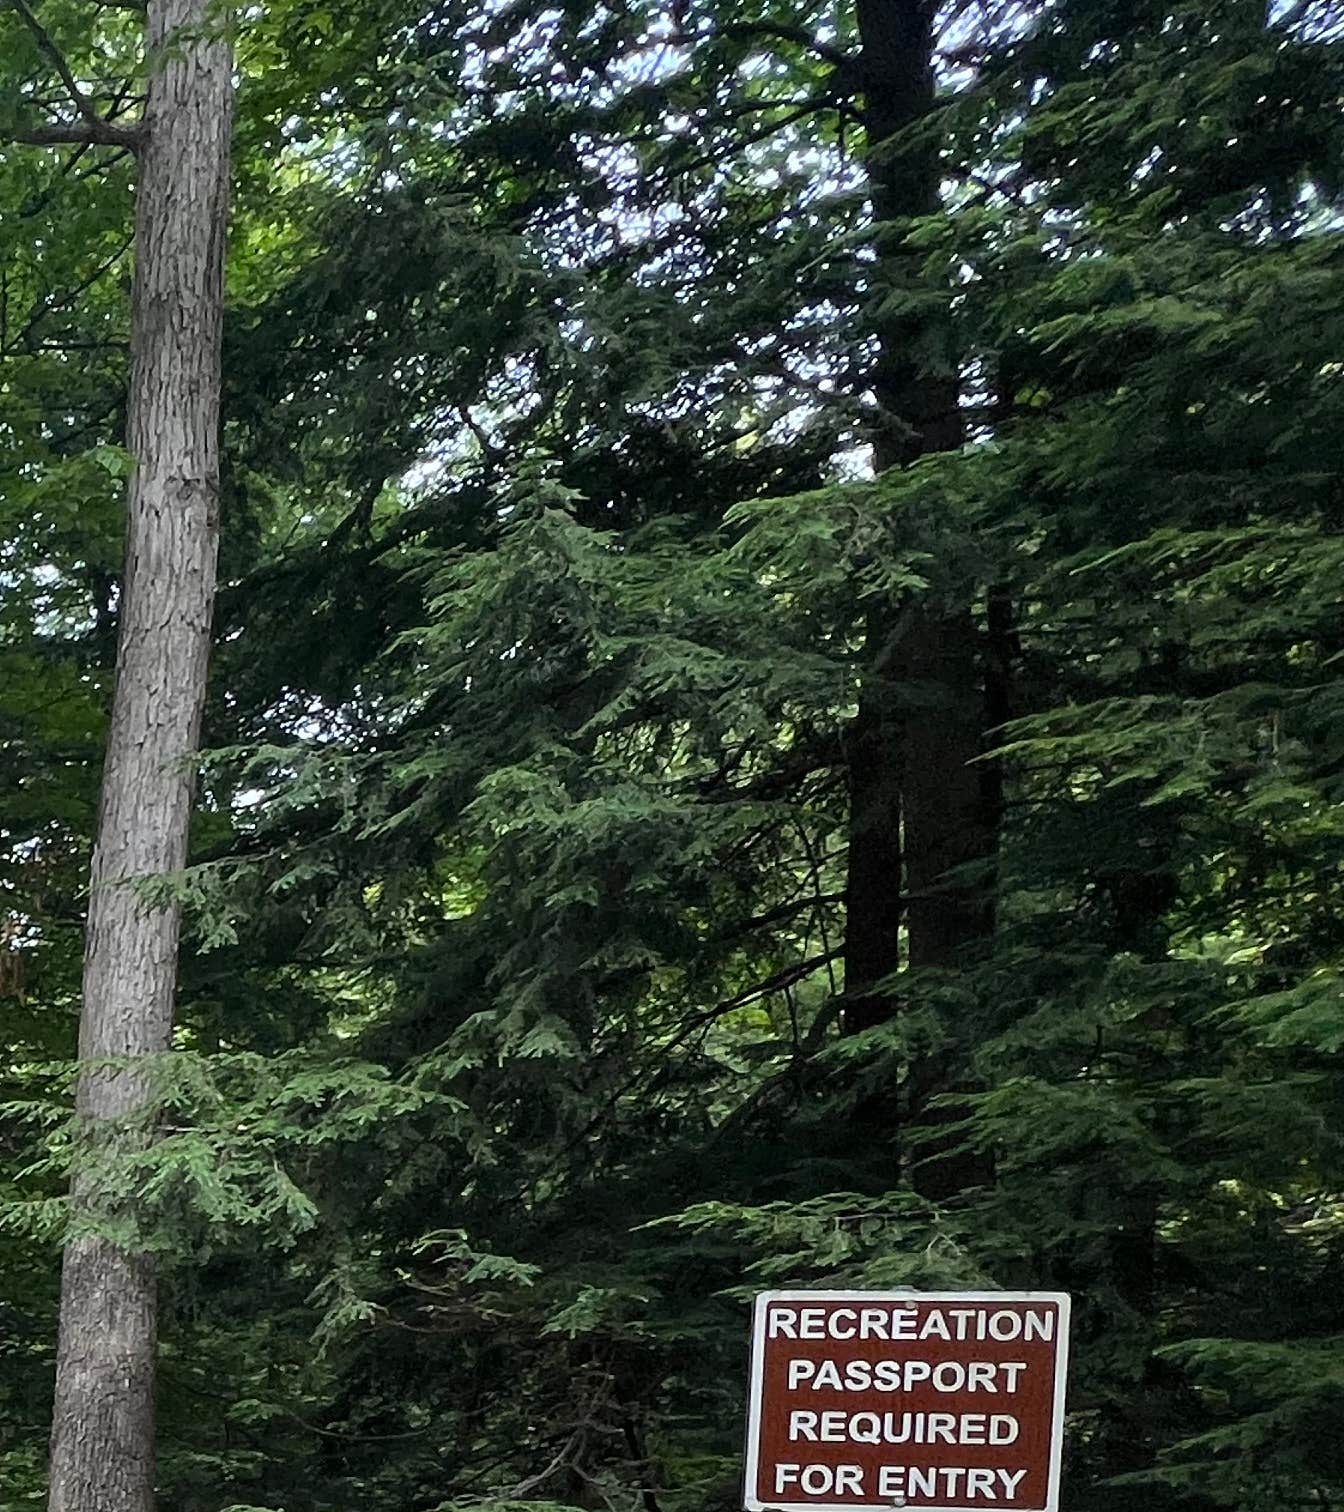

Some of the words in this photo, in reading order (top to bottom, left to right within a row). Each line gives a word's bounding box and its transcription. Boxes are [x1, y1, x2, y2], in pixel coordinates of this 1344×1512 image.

[768, 1308, 1054, 1342] RECREATION
[787, 1360, 1027, 1393] PASSPORT
[788, 1410, 1020, 1445] REQUIRED
[775, 1463, 865, 1497] FOR
[877, 1465, 1027, 1501] ENTRY
